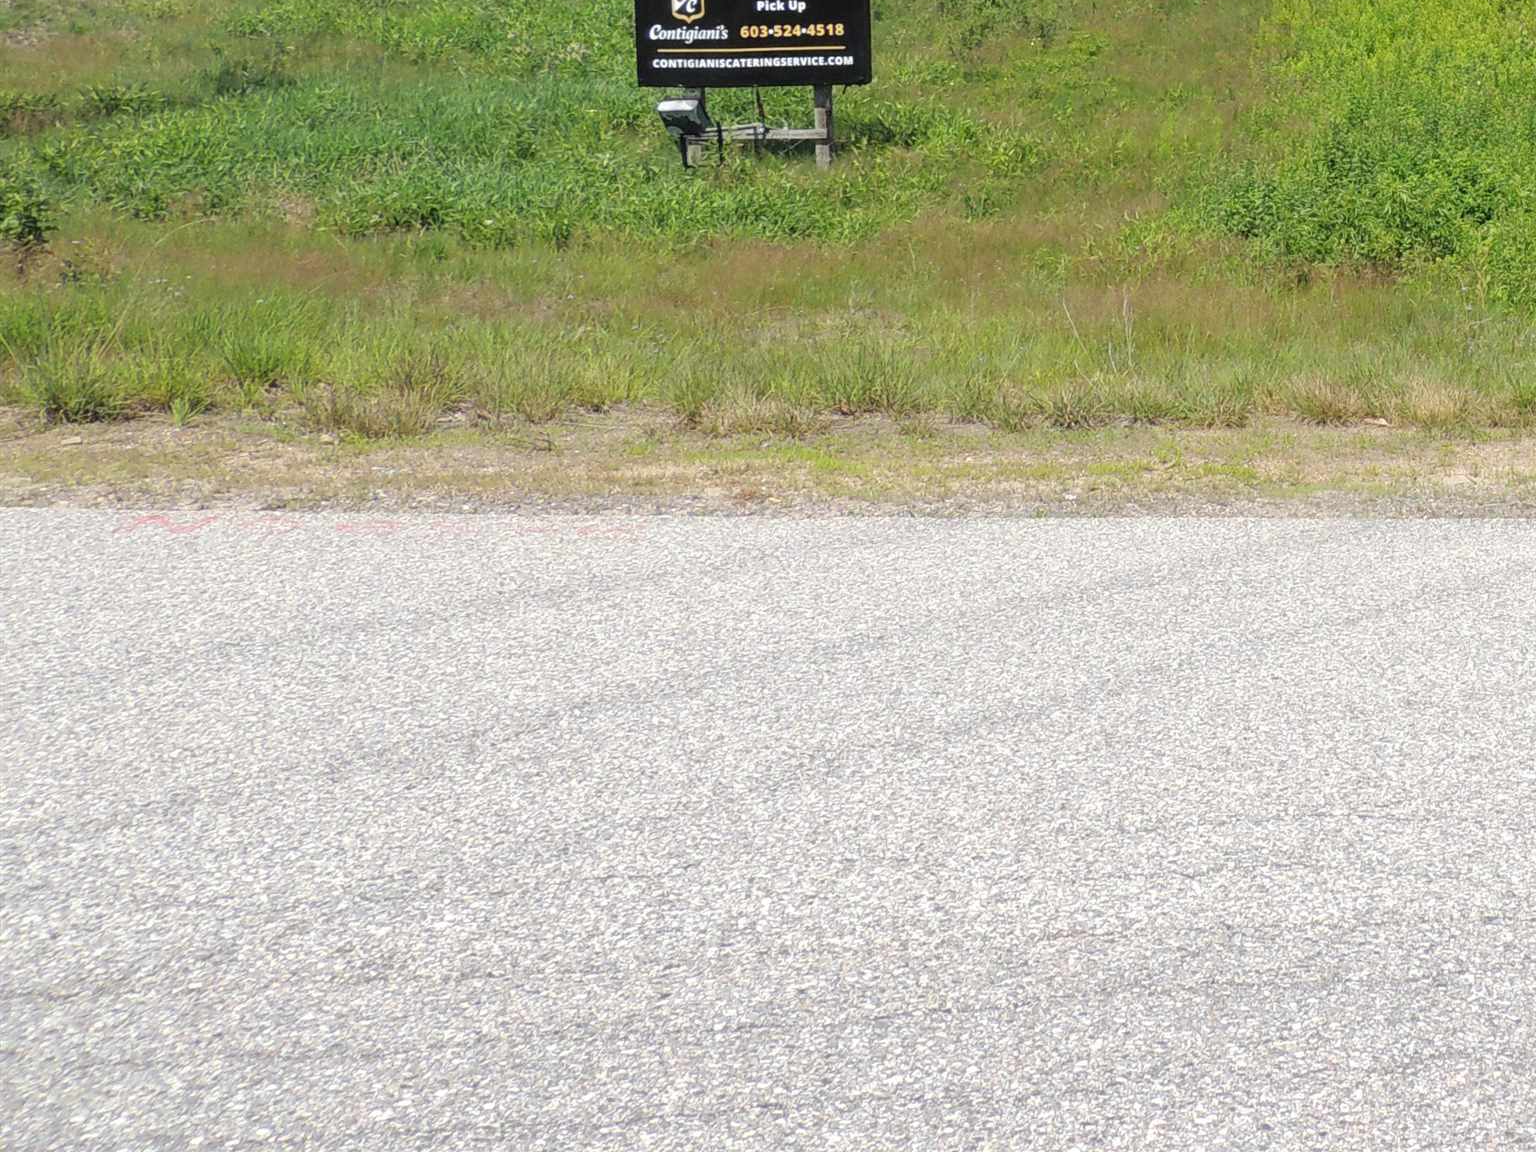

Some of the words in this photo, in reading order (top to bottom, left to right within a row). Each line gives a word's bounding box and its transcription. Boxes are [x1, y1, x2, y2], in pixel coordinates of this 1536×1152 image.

[757, 0, 784, 11] Pick
[789, 0, 806, 12] Up
[649, 24, 729, 44] Contigiani's
[652, 56, 854, 69] CONTIGIANISCATERINGSERVICE.COM
